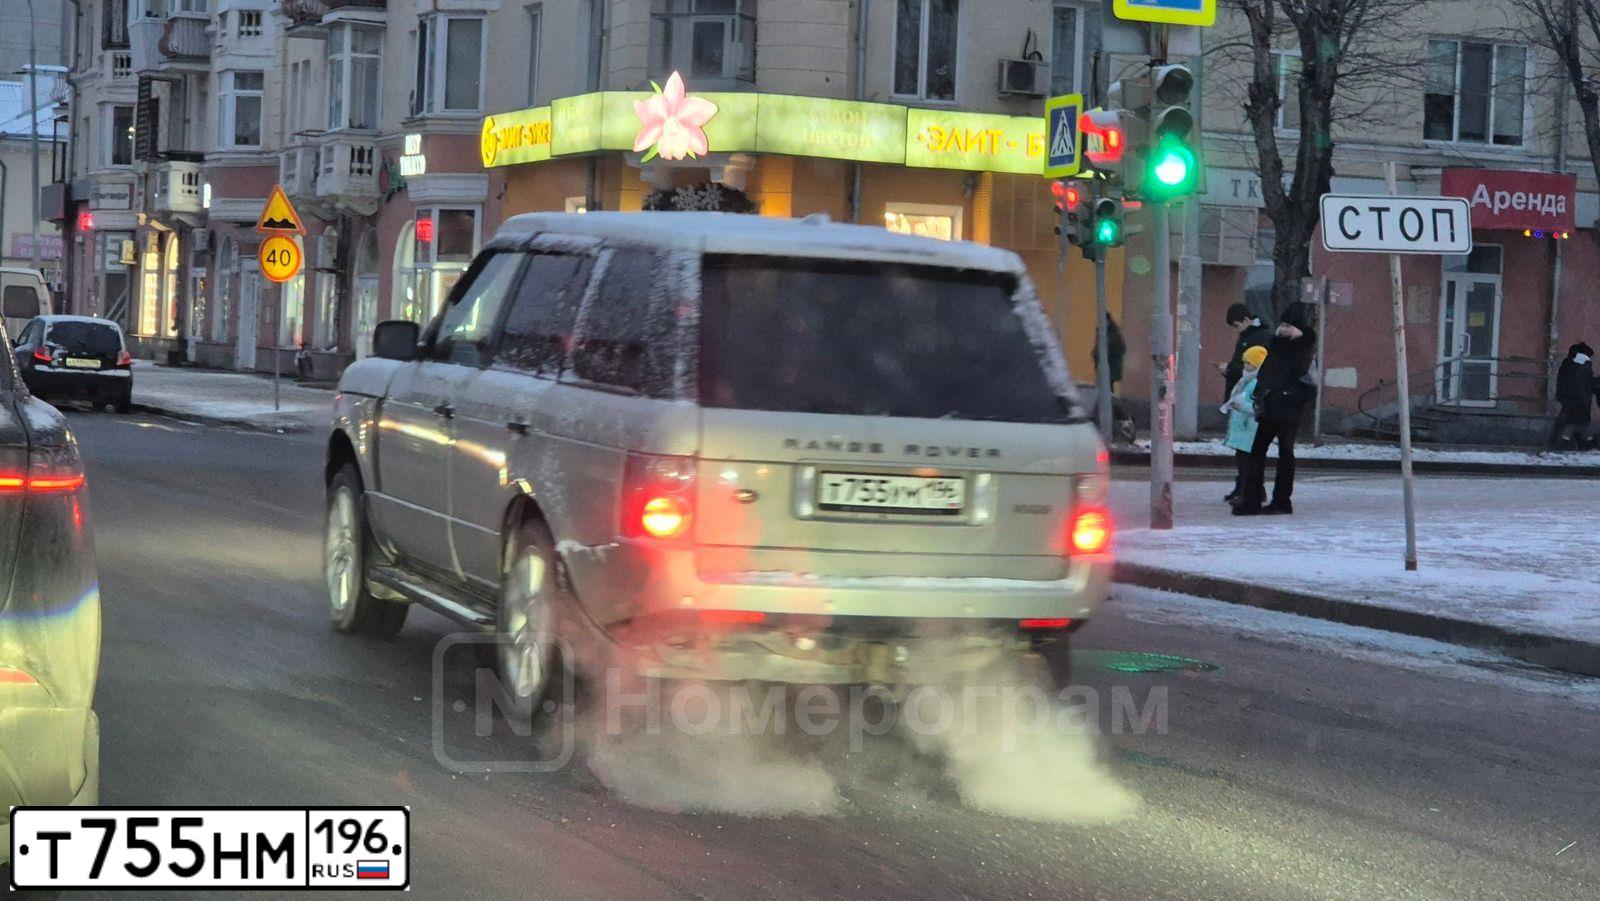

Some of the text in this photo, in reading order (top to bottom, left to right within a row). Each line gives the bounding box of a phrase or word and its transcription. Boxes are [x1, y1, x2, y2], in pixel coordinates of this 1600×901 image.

[1470, 183, 1566, 217] Аренда
[1338, 205, 1456, 243] СТОП
[266, 249, 291, 267] 40
[784, 438, 1001, 458] RANGE ROVER
